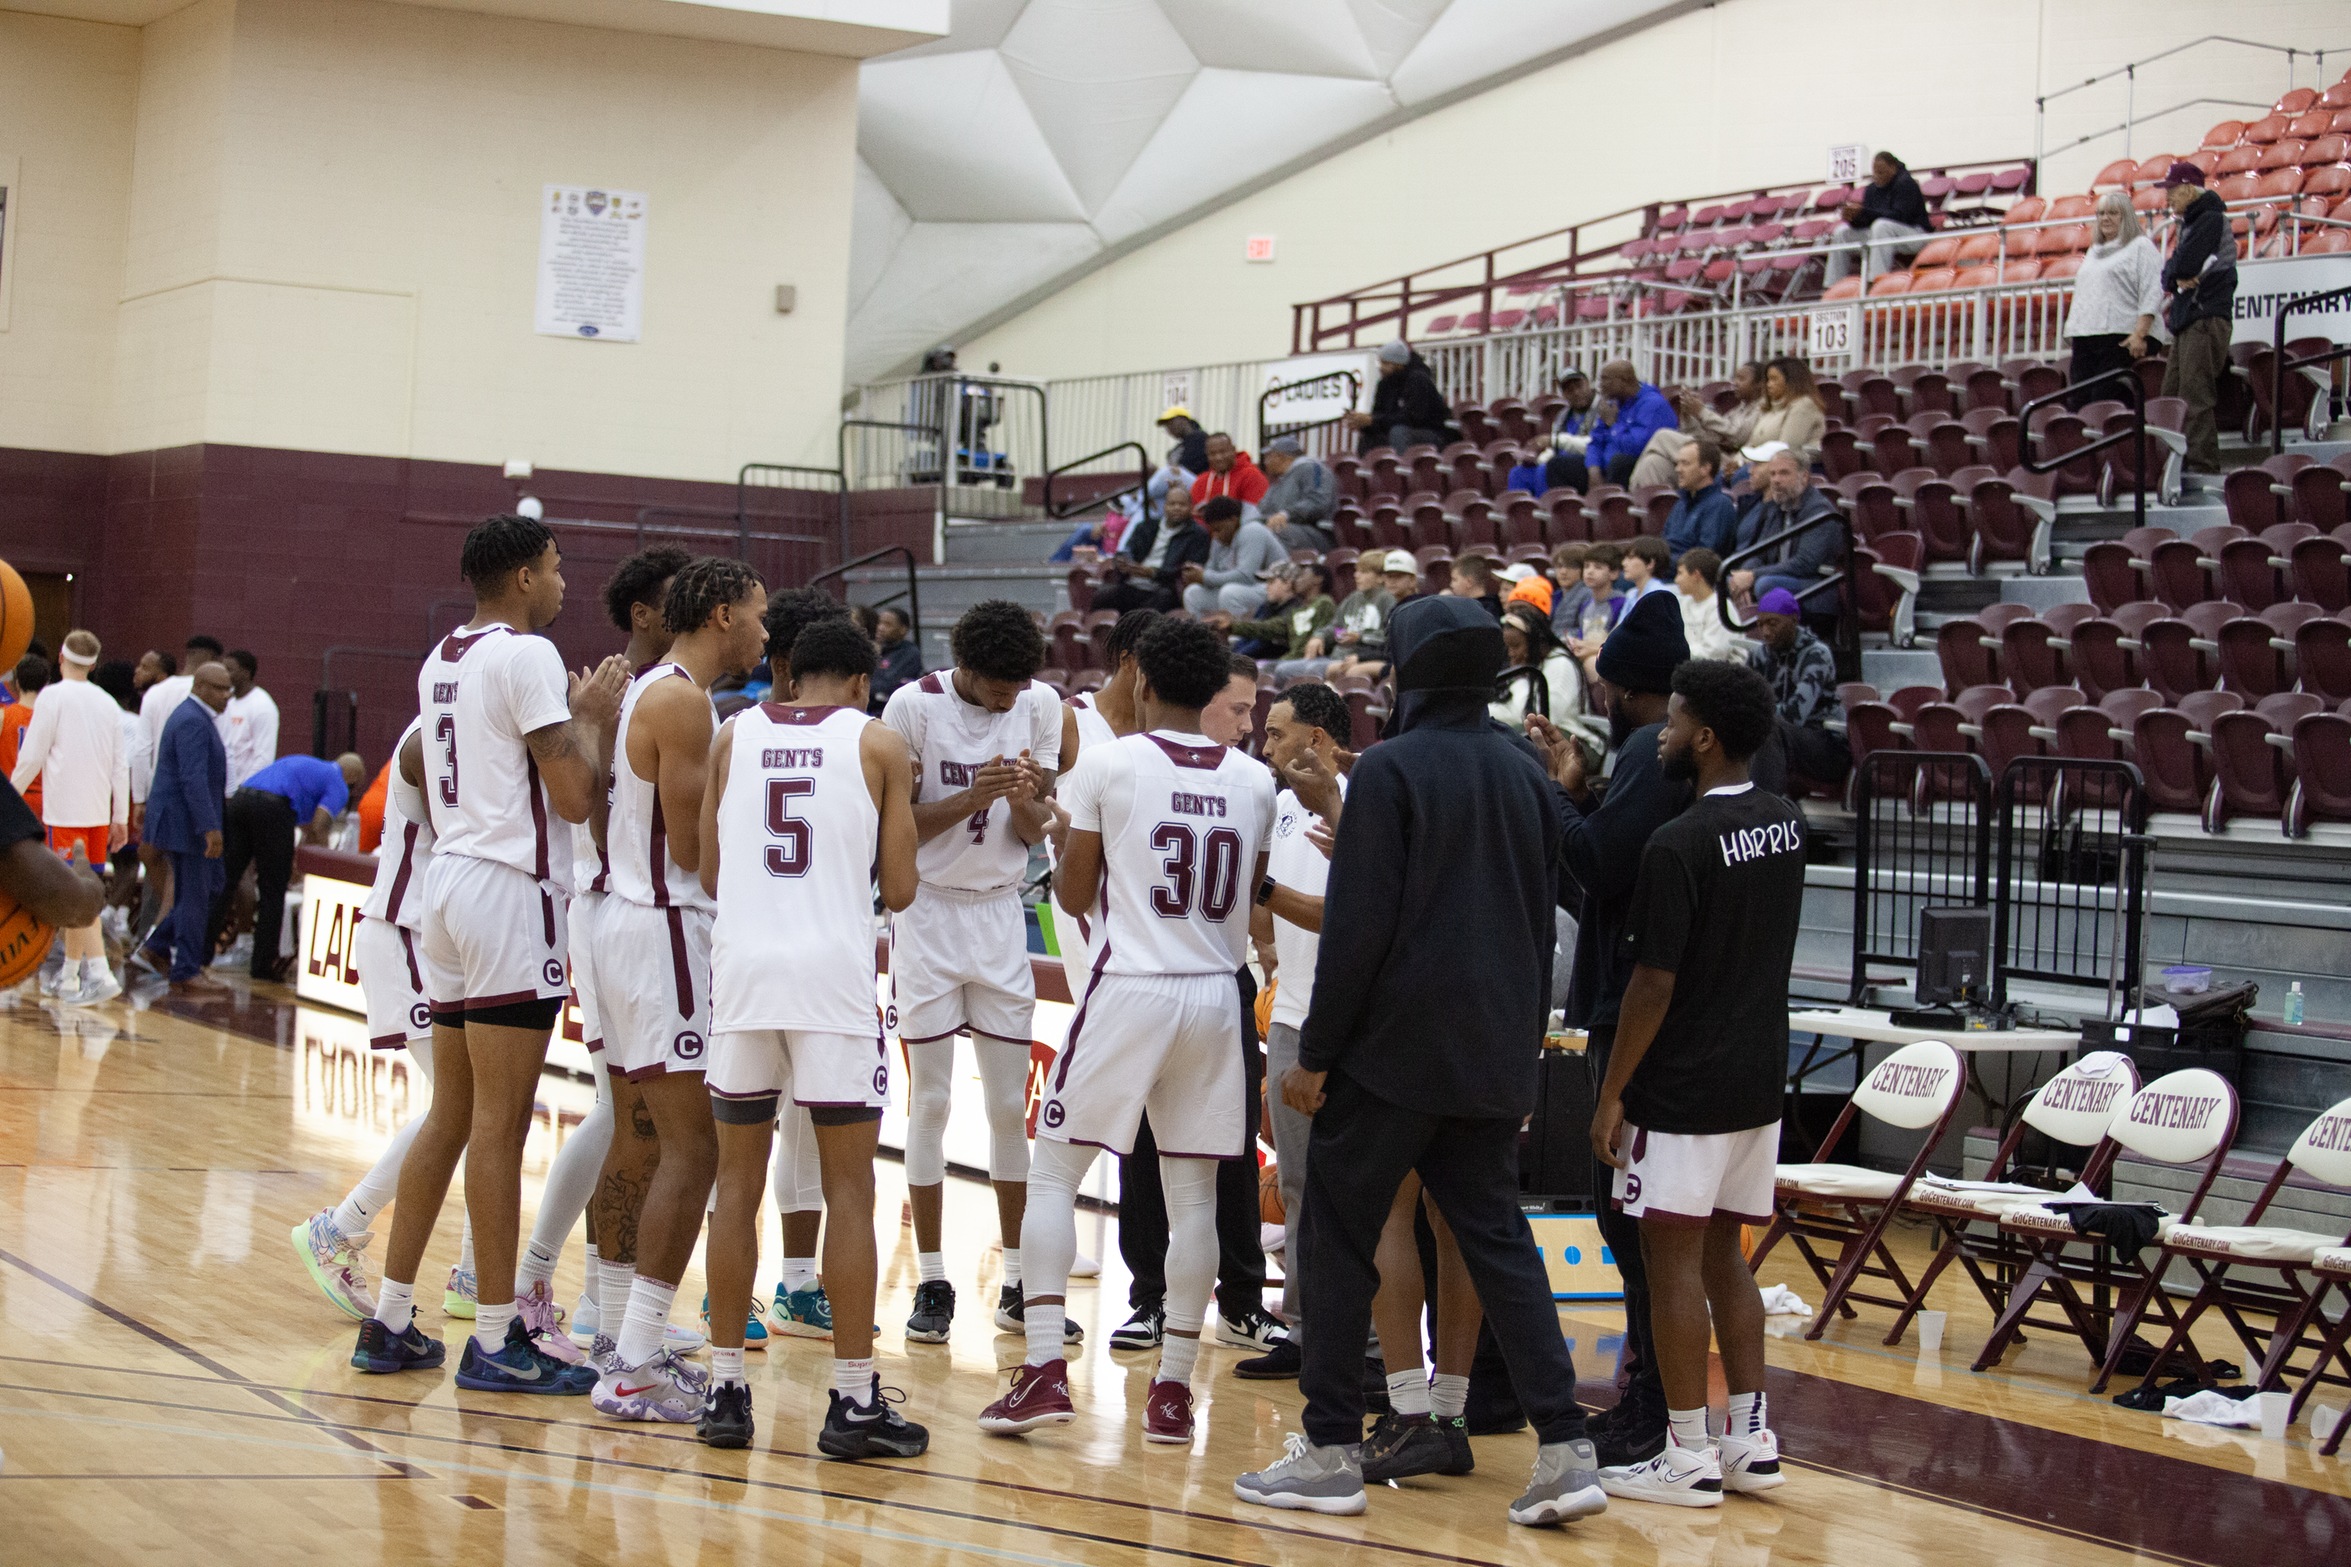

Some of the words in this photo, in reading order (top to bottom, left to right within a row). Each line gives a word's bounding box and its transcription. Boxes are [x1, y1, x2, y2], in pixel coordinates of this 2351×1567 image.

[1832, 159, 1856, 178] 205
[1816, 311, 1847, 323] SECTION
[1816, 323, 1847, 350] 103
[1286, 374, 1341, 401] LADIES
[436, 713, 459, 808] 3
[761, 747, 824, 769] GENTS
[1171, 791, 1227, 818] GENTS
[764, 777, 816, 878] 5
[967, 808, 989, 845] 4
[1719, 820, 1800, 867] HARRIS
[1150, 821, 1243, 923] 30
[1871, 1061, 1950, 1098] CENTENARY
[2043, 1077, 2125, 1113] CENTENARY
[2130, 1092, 2222, 1130] CENTENARY
